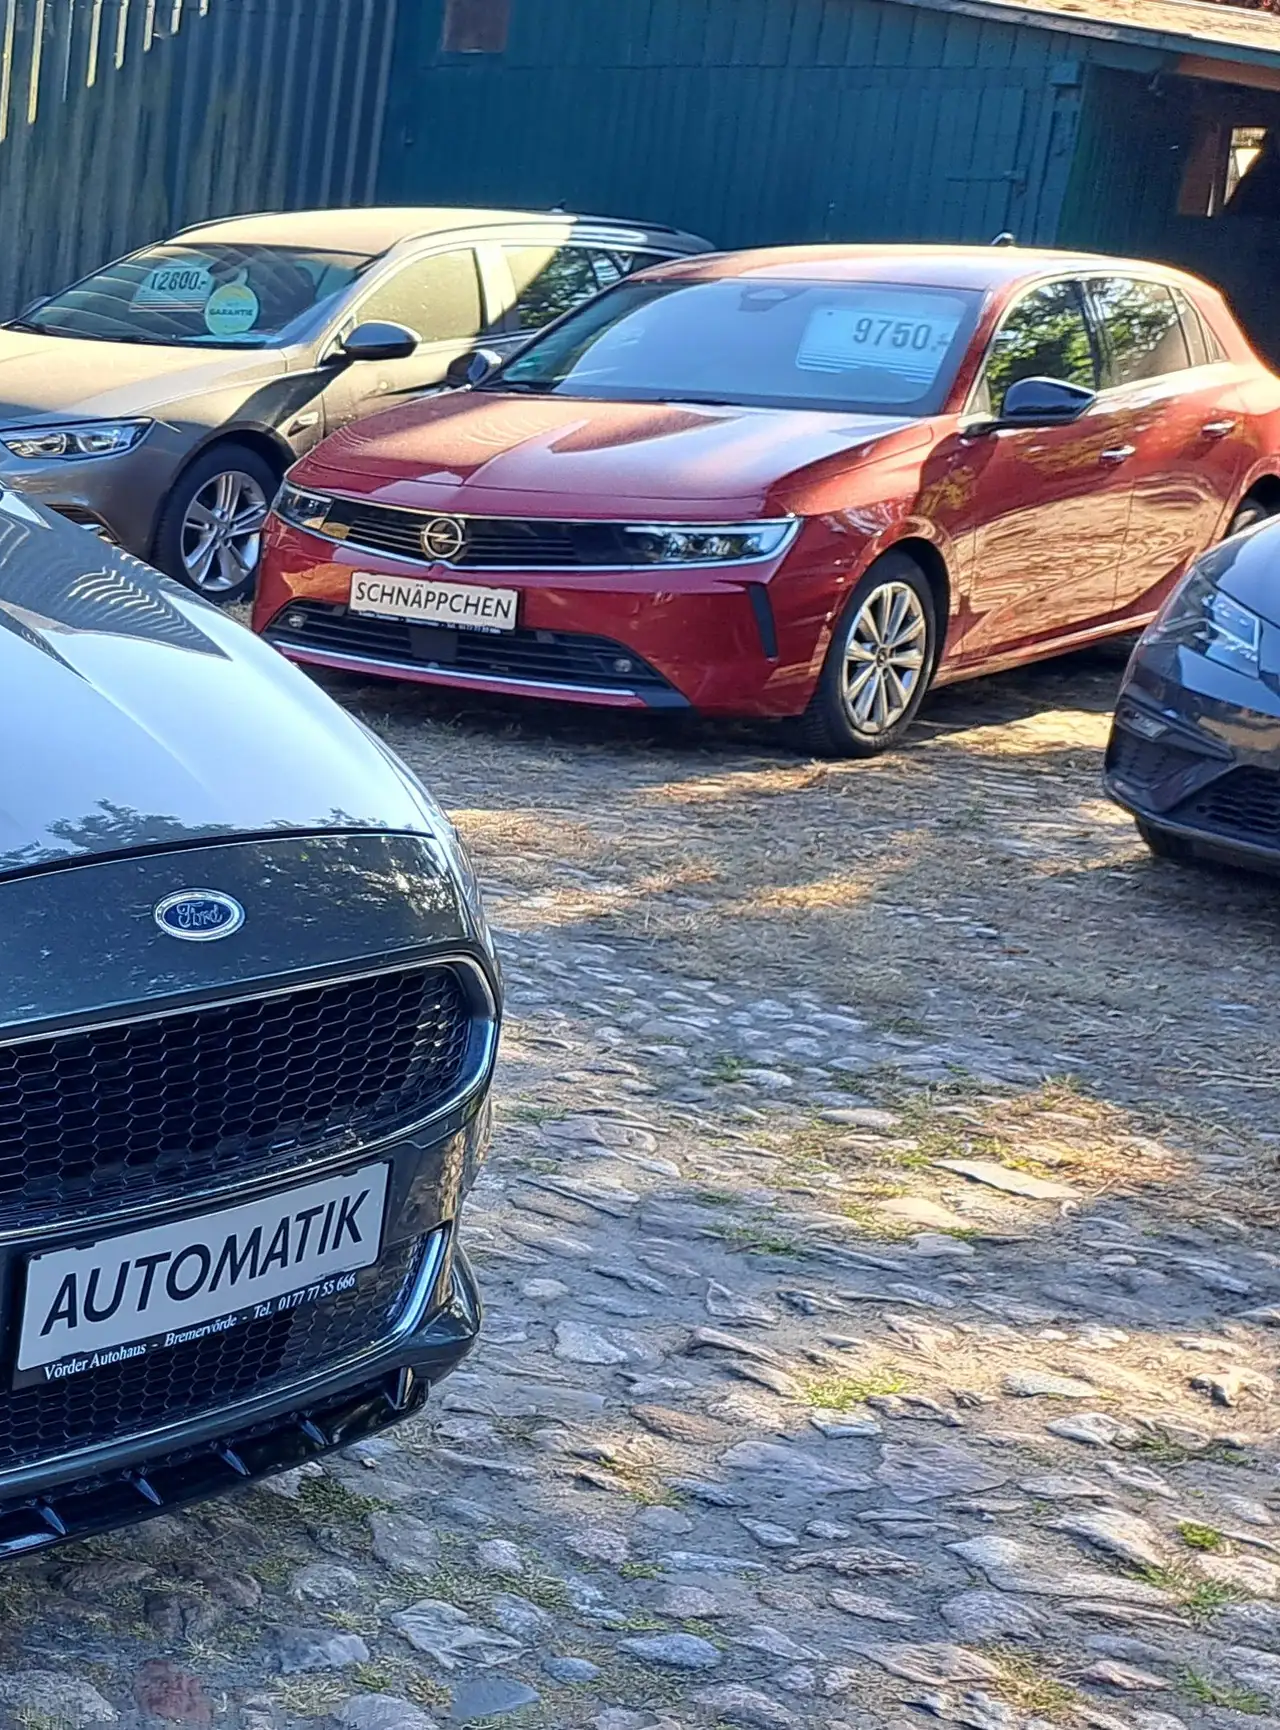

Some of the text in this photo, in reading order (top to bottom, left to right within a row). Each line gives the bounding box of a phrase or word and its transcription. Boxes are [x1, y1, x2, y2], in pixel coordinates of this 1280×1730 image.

[355, 582, 513, 619] SCHNÄPPCHEN
[176, 901, 223, 928] Ford
[39, 1189, 371, 1338] AUTOMATIK
[44, 1358, 89, 1381] Vörder
[89, 1343, 148, 1369] Autohaus
[163, 1315, 237, 1348] Bremervörde
[253, 1302, 273, 1320] Tel.
[278, 1290, 306, 1312] 0177
[306, 1285, 321, 1301] 77
[321, 1279, 335, 1298] 55
[336, 1272, 356, 1292] 666
